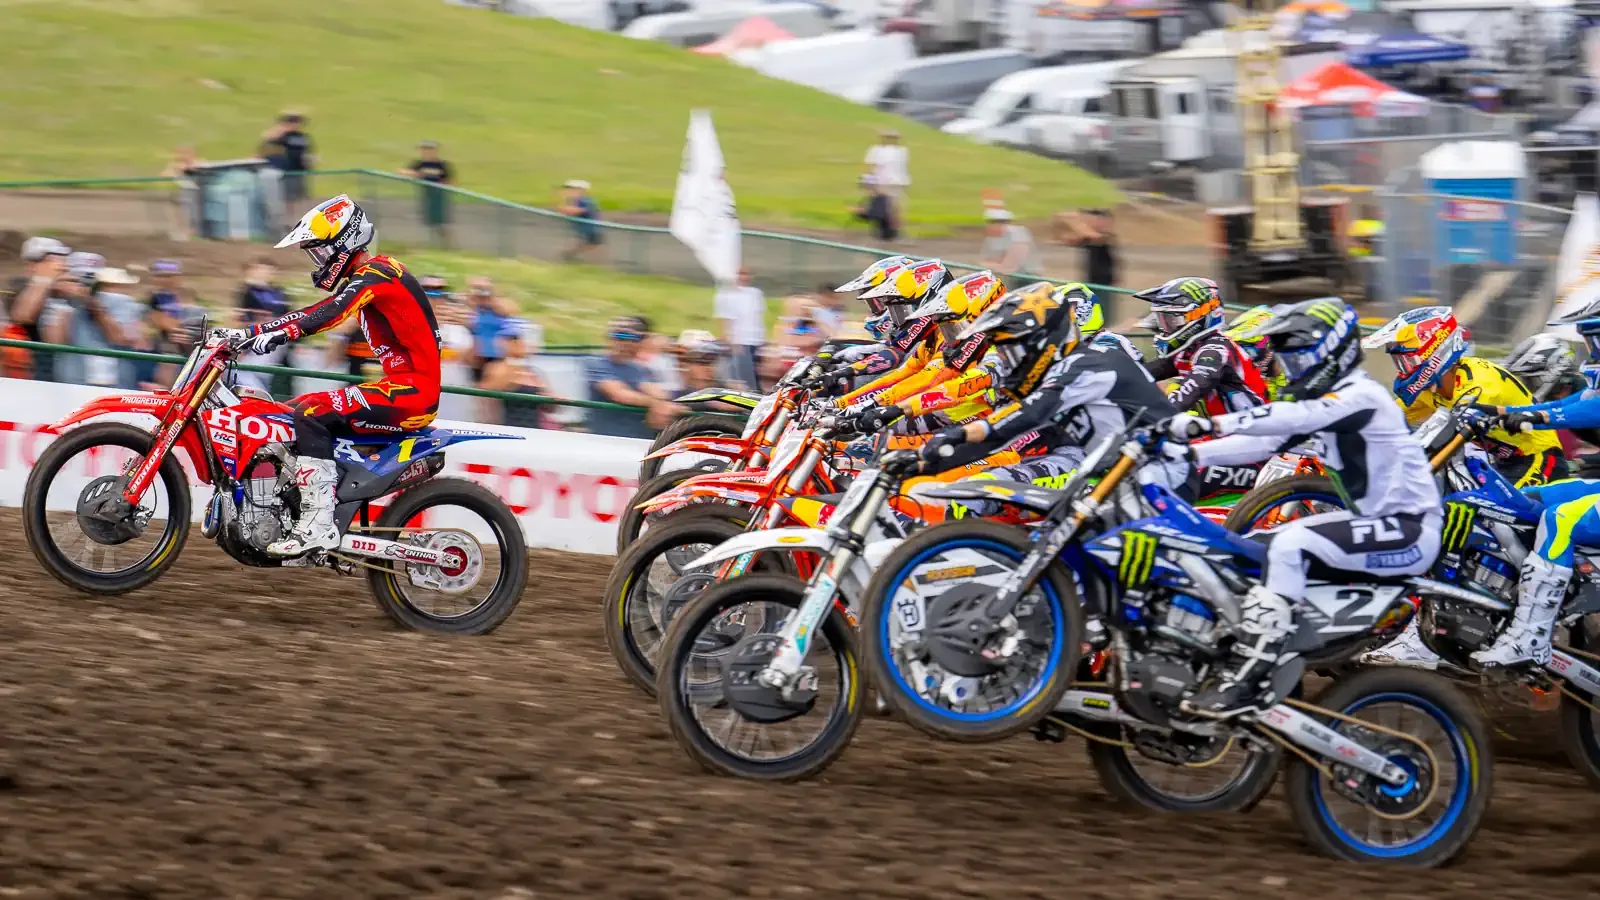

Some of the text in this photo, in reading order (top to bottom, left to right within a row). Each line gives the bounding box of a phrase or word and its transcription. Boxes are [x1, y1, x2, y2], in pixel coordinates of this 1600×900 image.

[264, 312, 308, 331] HONDA
[120, 396, 168, 406] PROGRESSIVE
[364, 423, 403, 432] HONDA
[398, 438, 416, 463] 1
[352, 540, 376, 552] DID
[1332, 589, 1374, 627] 2
